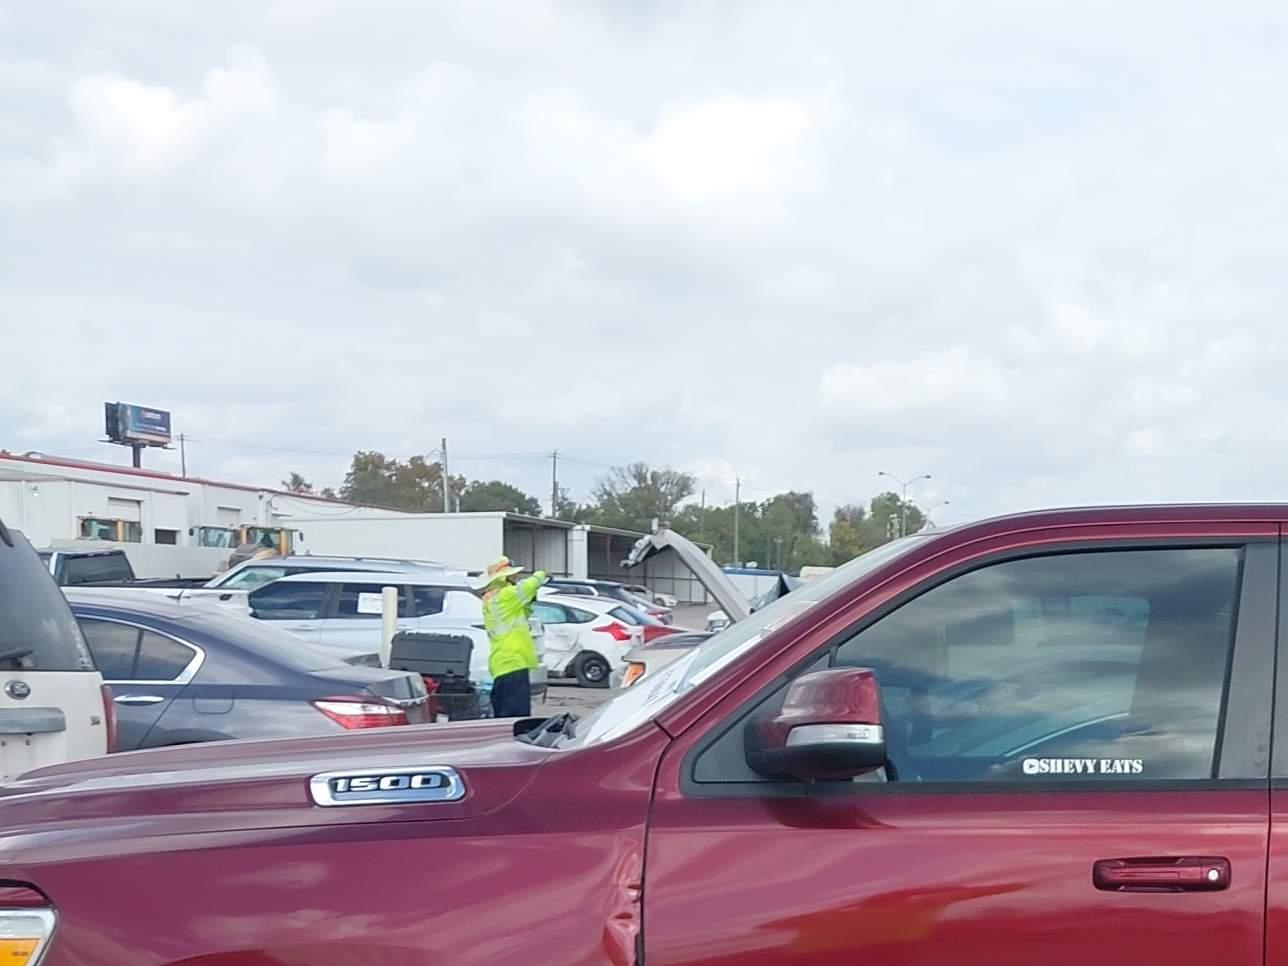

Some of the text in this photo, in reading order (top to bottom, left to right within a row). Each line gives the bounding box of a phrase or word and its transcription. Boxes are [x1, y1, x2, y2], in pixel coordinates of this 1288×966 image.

[1039, 758, 1143, 774] SHEVY EATS
[334, 774, 442, 792] 1500
